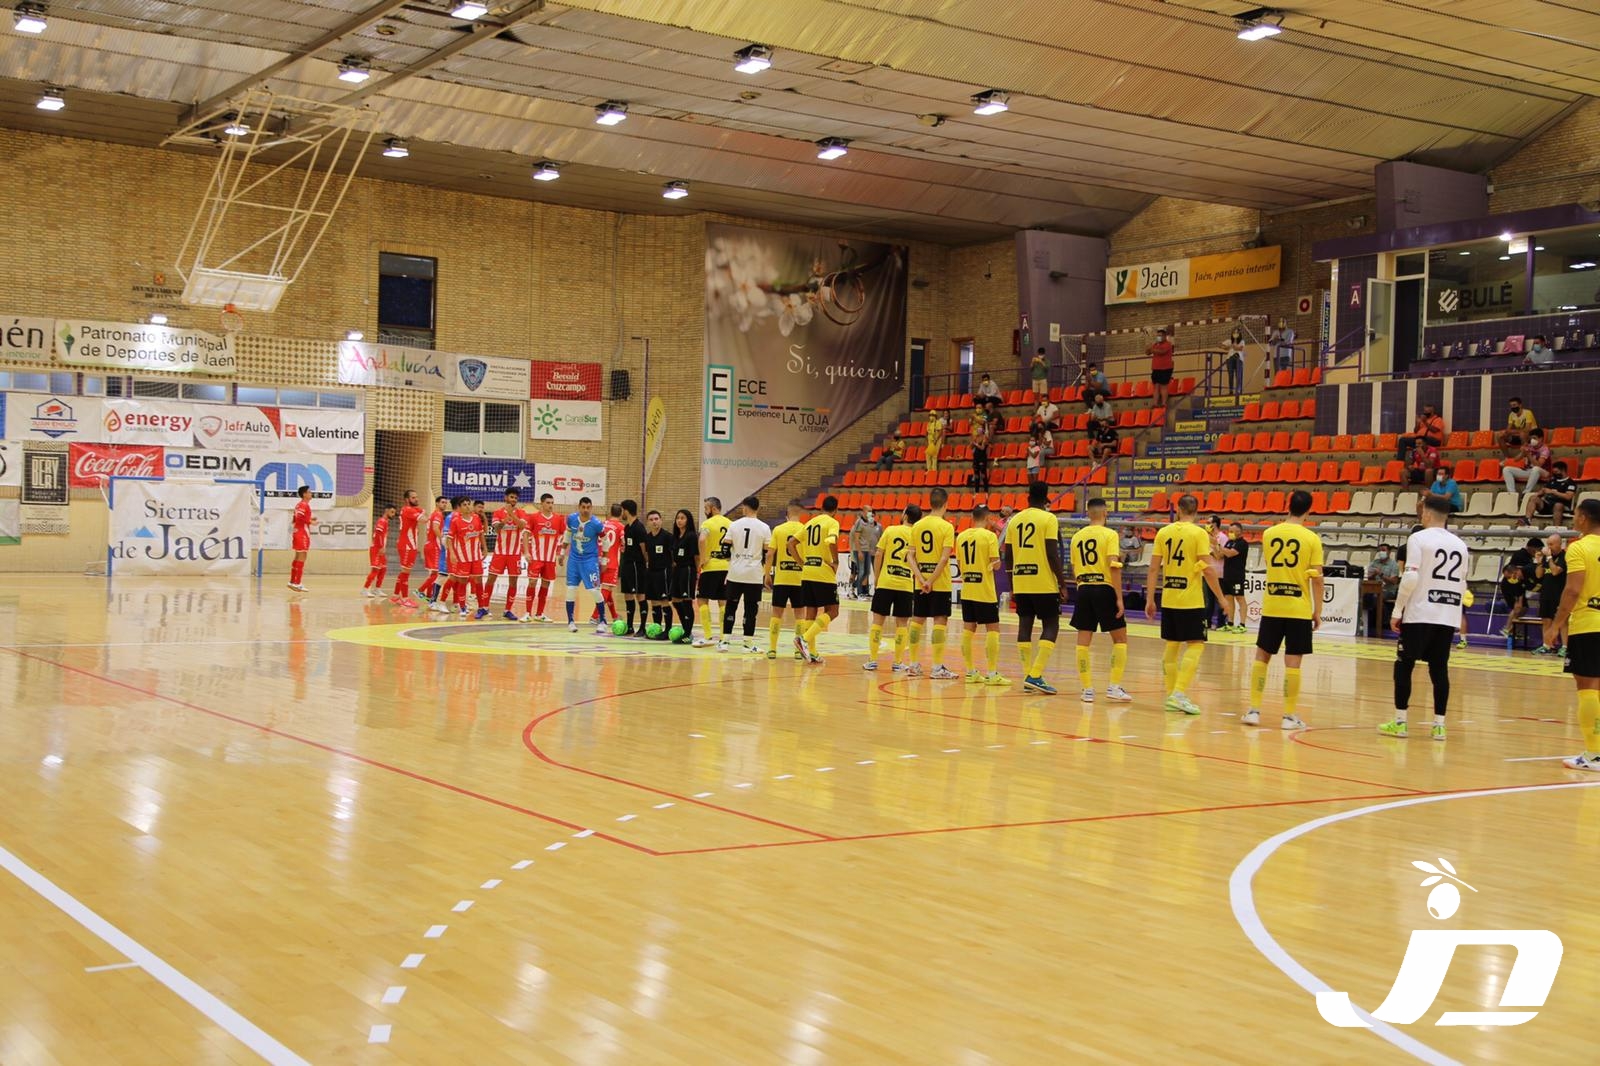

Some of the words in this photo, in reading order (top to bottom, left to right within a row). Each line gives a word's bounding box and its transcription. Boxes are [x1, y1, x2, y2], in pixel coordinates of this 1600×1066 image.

[1142, 265, 1178, 290] Jaén
[1246, 262, 1276, 274] interior
[1351, 290, 1360, 305] A
[1460, 281, 1512, 308] BULÉ
[0, 319, 44, 349] én
[81, 326, 156, 343] Patronato
[162, 331, 228, 351] Municipal
[81, 344, 101, 356] de
[106, 345, 176, 362] Deportes
[181, 352, 199, 362] de
[203, 354, 234, 366] Jaén
[349, 346, 446, 380] Andalucía
[825, 360, 890, 384] quiero
[546, 376, 586, 392] Cruzcampo
[738, 380, 768, 395] ECE
[125, 412, 192, 432] energy
[738, 409, 780, 419] Experience
[782, 413, 796, 424] LA
[800, 414, 830, 426] TOJA
[298, 426, 360, 440] Valentine
[798, 425, 830, 433] CATERING
[165, 454, 250, 472] OEDIM
[448, 468, 508, 487] luanvi
[144, 500, 220, 520] Sierras
[112, 541, 136, 558] de
[144, 524, 248, 560] Jaén
[744, 528, 750, 549] 1
[806, 524, 820, 546] 10
[920, 530, 934, 554] 9
[1016, 522, 1036, 548] 12
[961, 540, 976, 564] 11
[1076, 539, 1098, 566] 18
[1165, 538, 1184, 566] 14
[1270, 538, 1300, 568] 23
[1432, 548, 1462, 582] 22
[590, 573, 598, 582] 16
